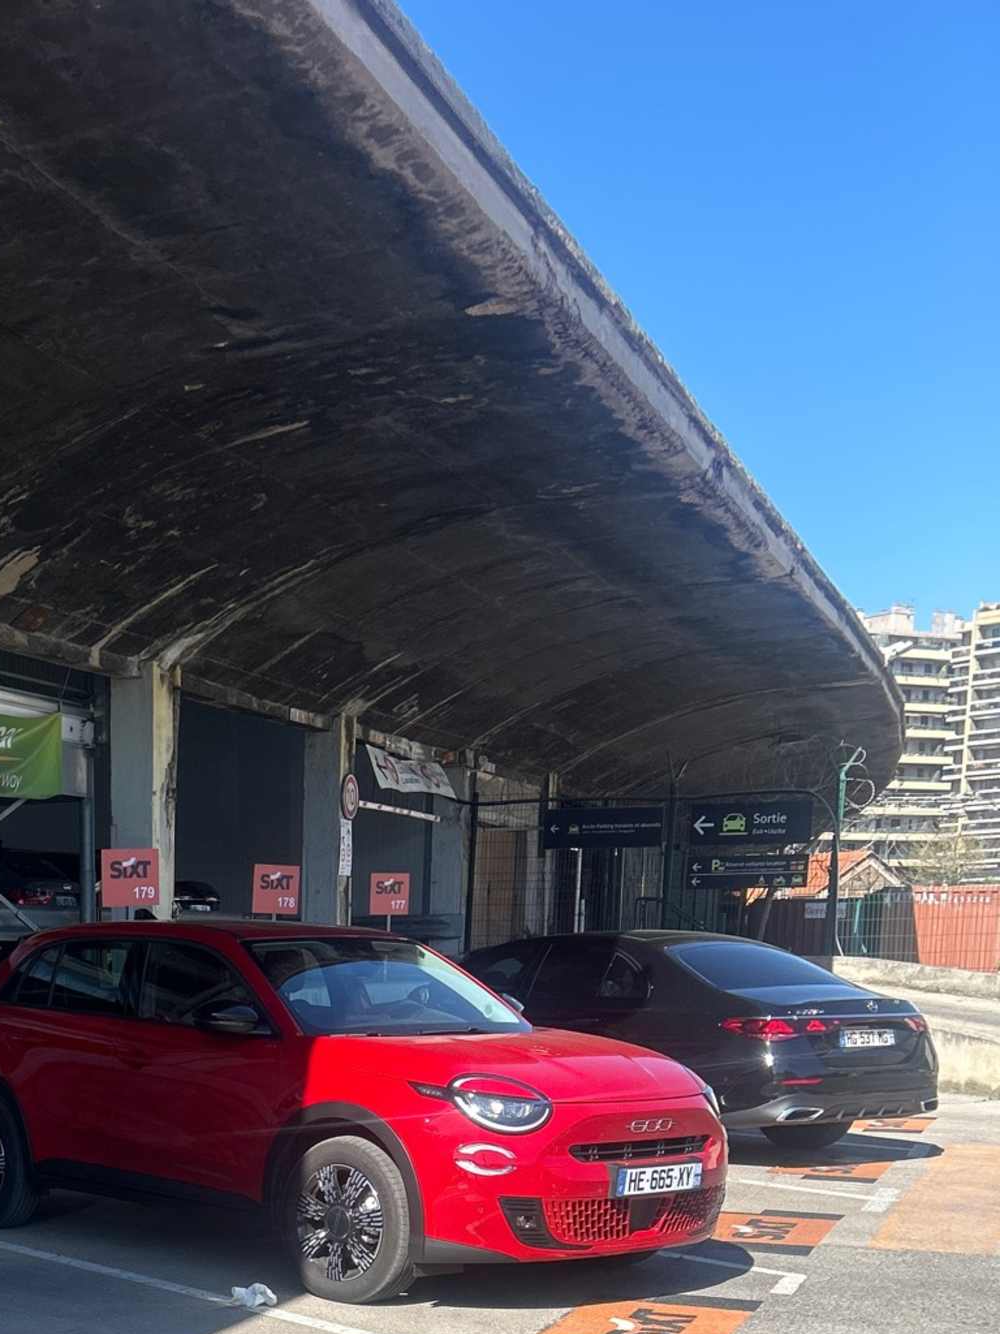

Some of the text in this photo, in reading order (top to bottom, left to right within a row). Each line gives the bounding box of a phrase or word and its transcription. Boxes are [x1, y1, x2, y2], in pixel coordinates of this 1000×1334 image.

[753, 812, 788, 824] Sortie
[133, 887, 155, 899] 179
[277, 897, 296, 908] 178
[390, 900, 406, 910] 177
[628, 1166, 693, 1192] HE-665-XY
